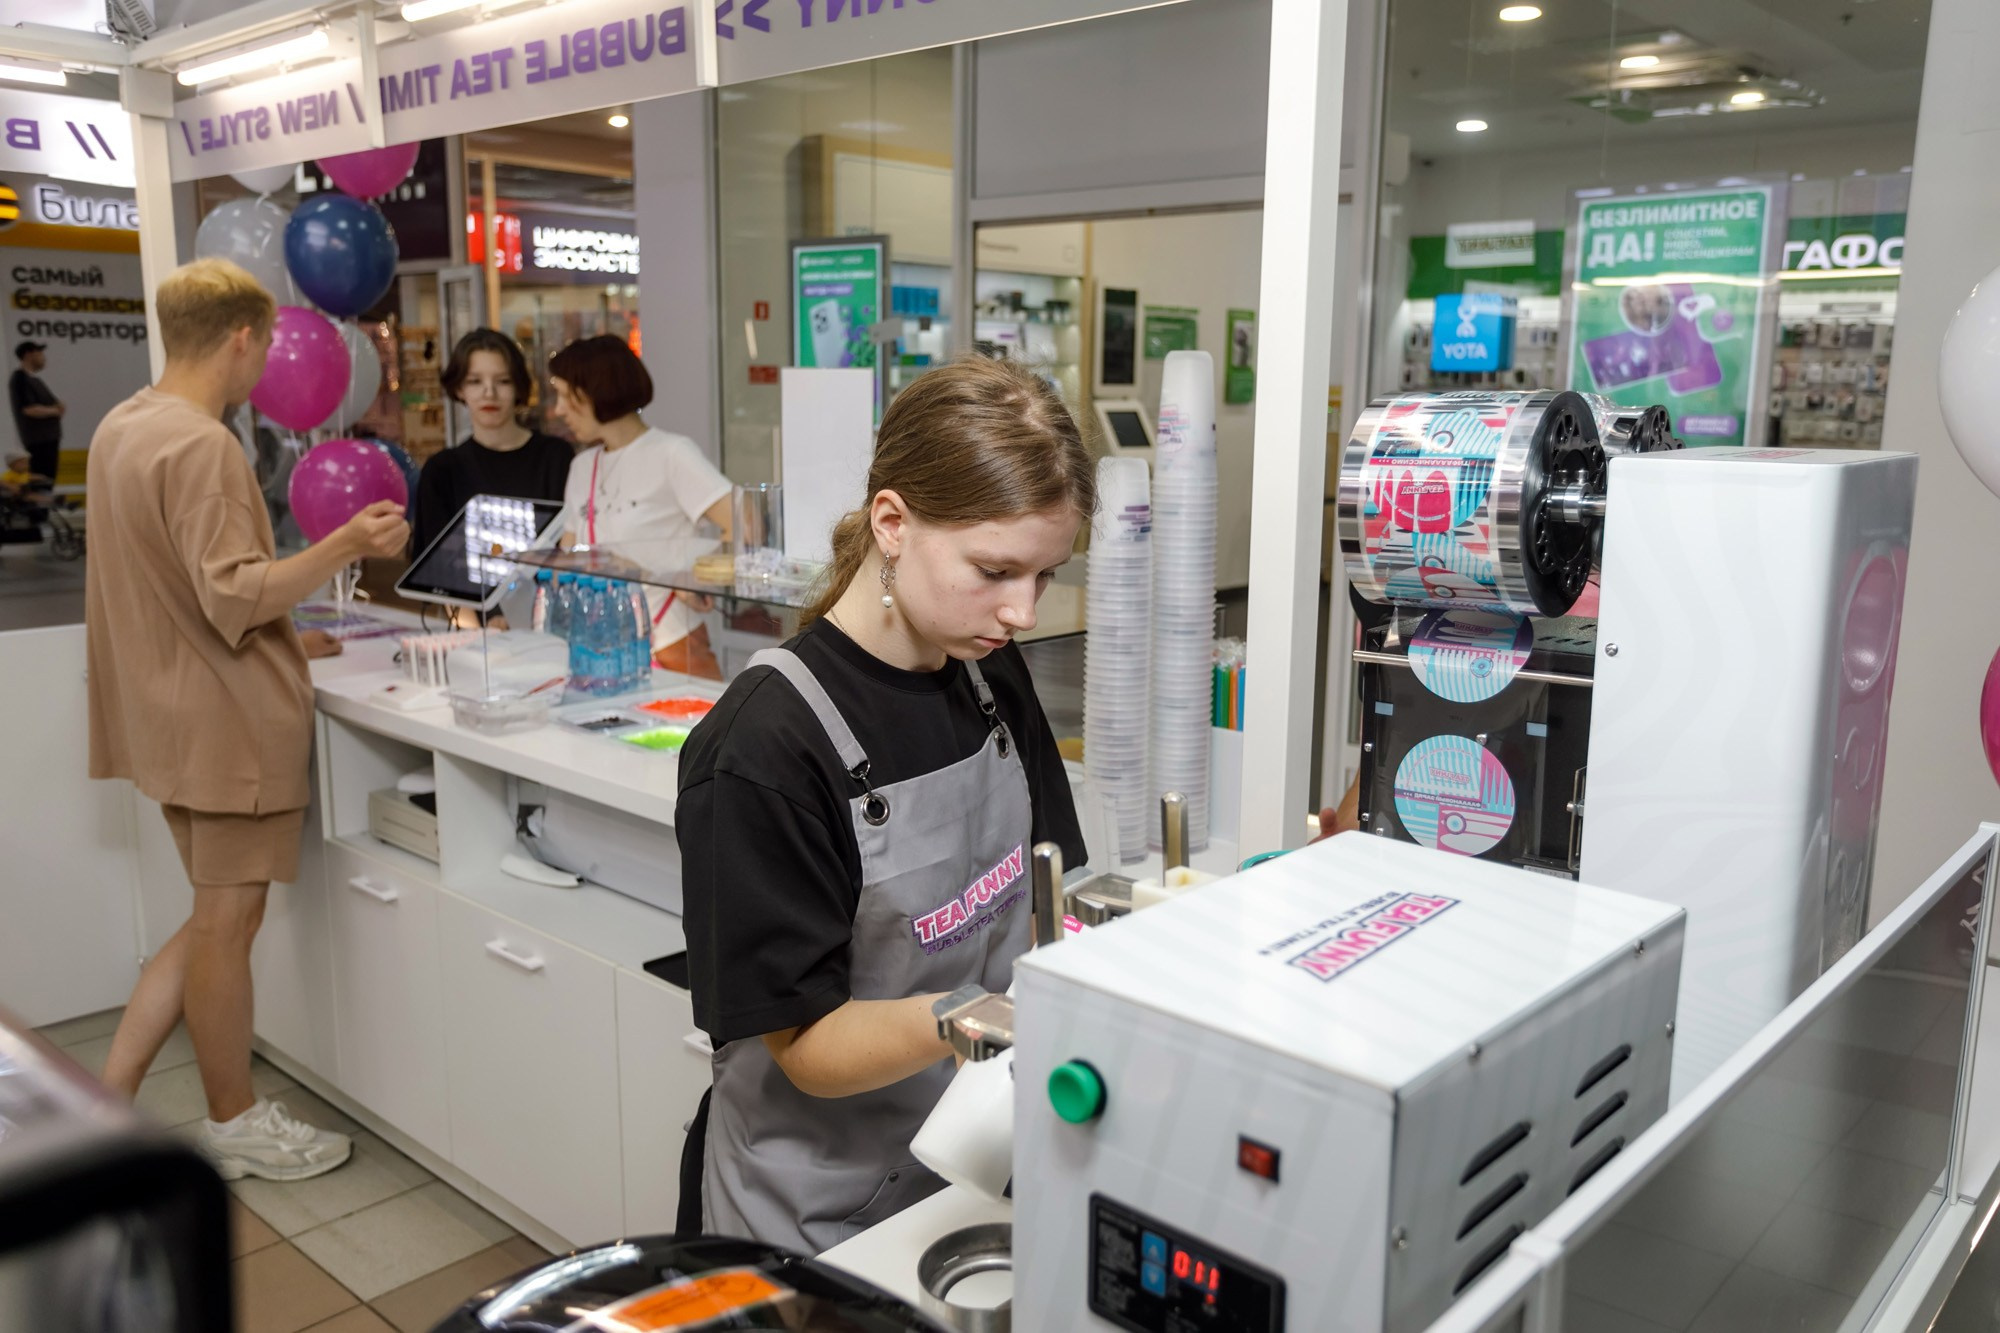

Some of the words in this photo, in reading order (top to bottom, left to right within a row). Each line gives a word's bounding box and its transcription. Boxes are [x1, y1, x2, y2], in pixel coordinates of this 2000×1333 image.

[1590, 199, 1758, 228] БЕЗЛИМИТНОЕ
[1587, 230, 1655, 269] ДА!
[12, 265, 104, 286] самый
[17, 319, 148, 345] оператор
[1442, 342, 1488, 359] YOTA
[915, 899, 967, 945] TEA
[964, 845, 1024, 917] FUNNY
[1378, 894, 1453, 923] TEA
[1298, 918, 1405, 979] FUNNY
